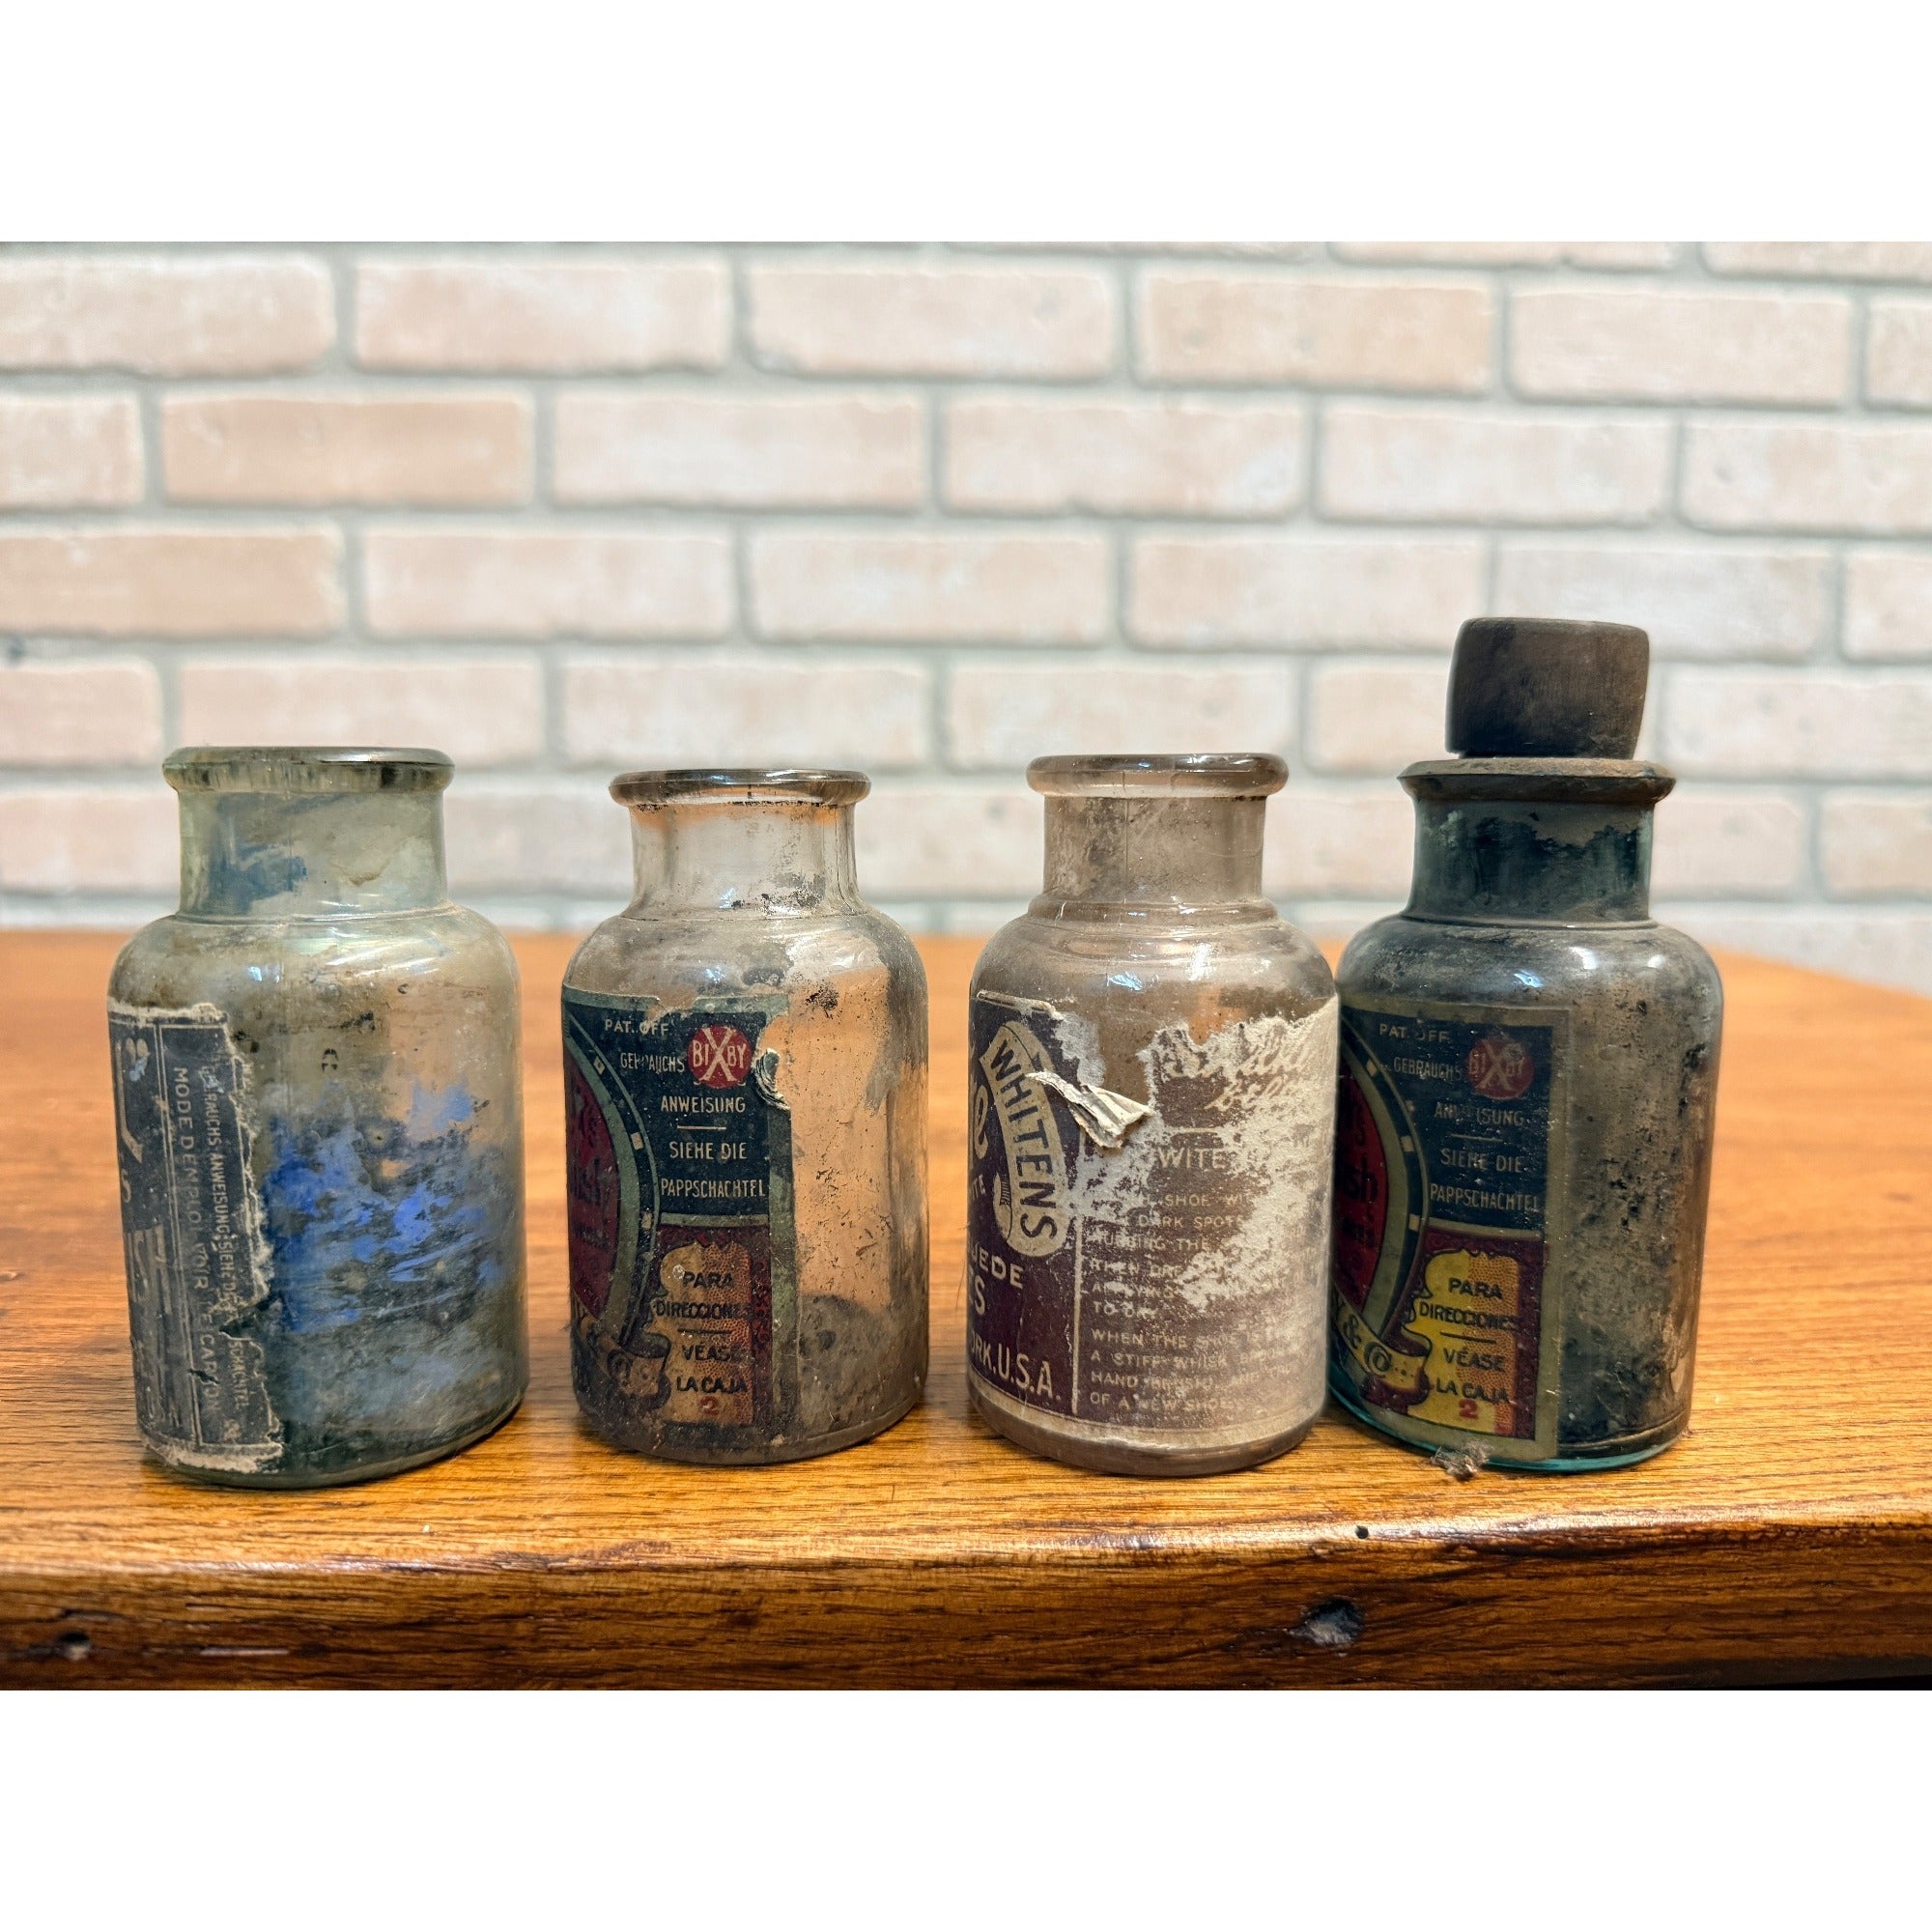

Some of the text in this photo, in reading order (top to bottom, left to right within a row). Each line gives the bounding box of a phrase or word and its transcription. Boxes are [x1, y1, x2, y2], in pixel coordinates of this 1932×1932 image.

[1379, 1023, 1409, 1039] PAT.
[620, 1052, 687, 1074] GEAUCHS
[691, 1024, 748, 1082] BIXBY
[1393, 1057, 1463, 1083] GEBRAUCHS
[661, 1094, 747, 1114] ANWEISUNG
[1434, 1101, 1525, 1127] ANISUNG
[990, 1038, 1058, 1240] WHITENS
[669, 1141, 748, 1160] SIEHE DIE
[1439, 1148, 1523, 1174] SIEHE DIE
[661, 1178, 766, 1199] PAPPSCHACHTEL
[1430, 1182, 1540, 1213] PAPPSCHACHTEL
[1164, 1194, 1212, 1208] SHOE
[1138, 1213, 1184, 1229] DRK
[174, 1066, 194, 1130] MODE
[200, 1333, 221, 1412] CARON
[1176, 1237, 1211, 1252] THE
[683, 1271, 733, 1289] PARA
[1448, 1277, 1503, 1300] PARA
[1418, 1301, 1519, 1331] DIRECCIONES
[1091, 1327, 1145, 1347] WHEN
[1091, 1350, 1101, 1363] A
[676, 1376, 748, 1395] LA CAJA
[1090, 1371, 1139, 1389] HAND
[1435, 1377, 1511, 1404] LA CAJA
[699, 1395, 721, 1416] 2
[1089, 1391, 1112, 1406] OF
[1118, 1396, 1131, 1411] A
[1458, 1399, 1479, 1420] 2
